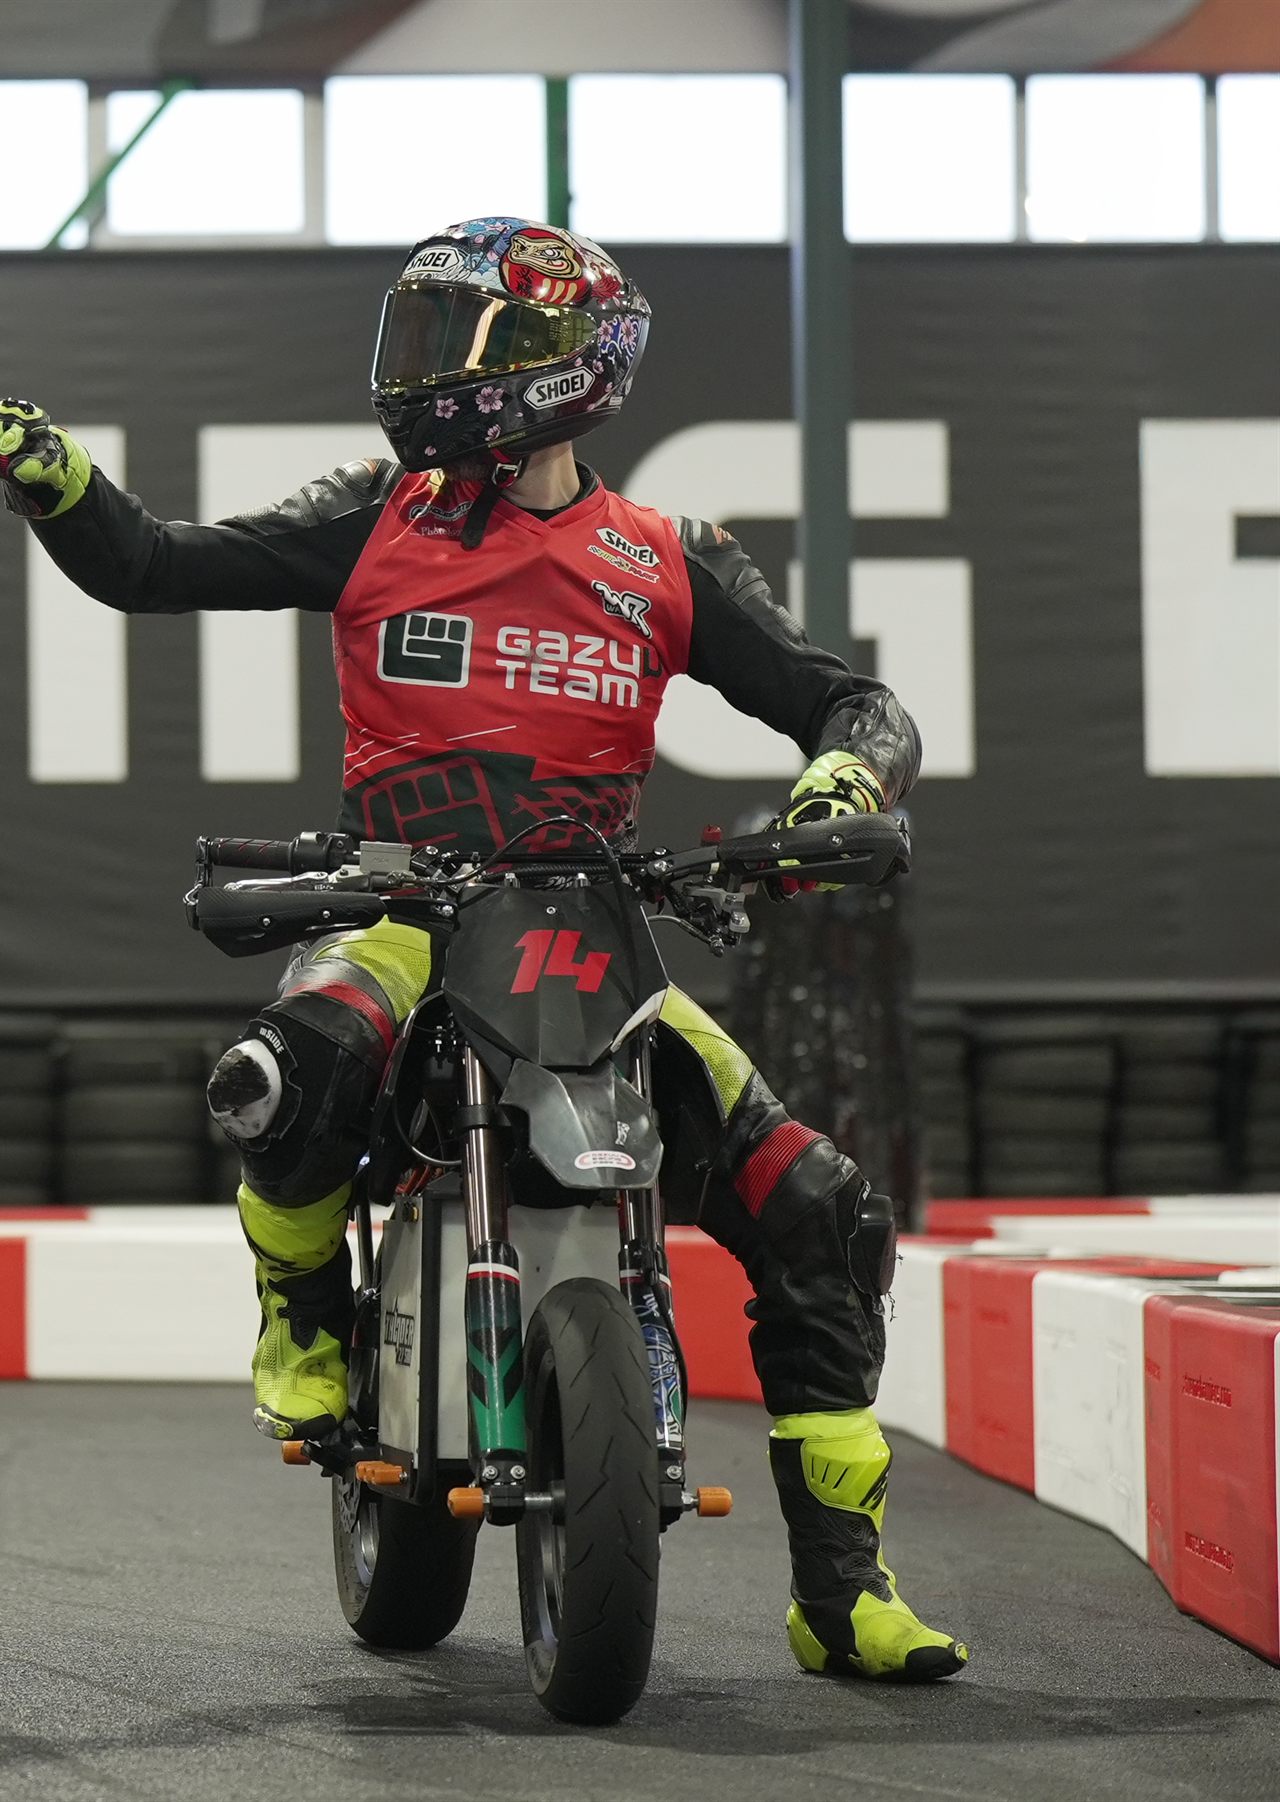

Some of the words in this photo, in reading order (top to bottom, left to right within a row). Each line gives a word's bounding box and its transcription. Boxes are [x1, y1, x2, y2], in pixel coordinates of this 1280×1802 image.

[407, 252, 449, 271] SHOEI
[535, 373, 586, 403] SHOEI
[604, 530, 654, 564] SHOEI
[510, 929, 612, 994] 14
